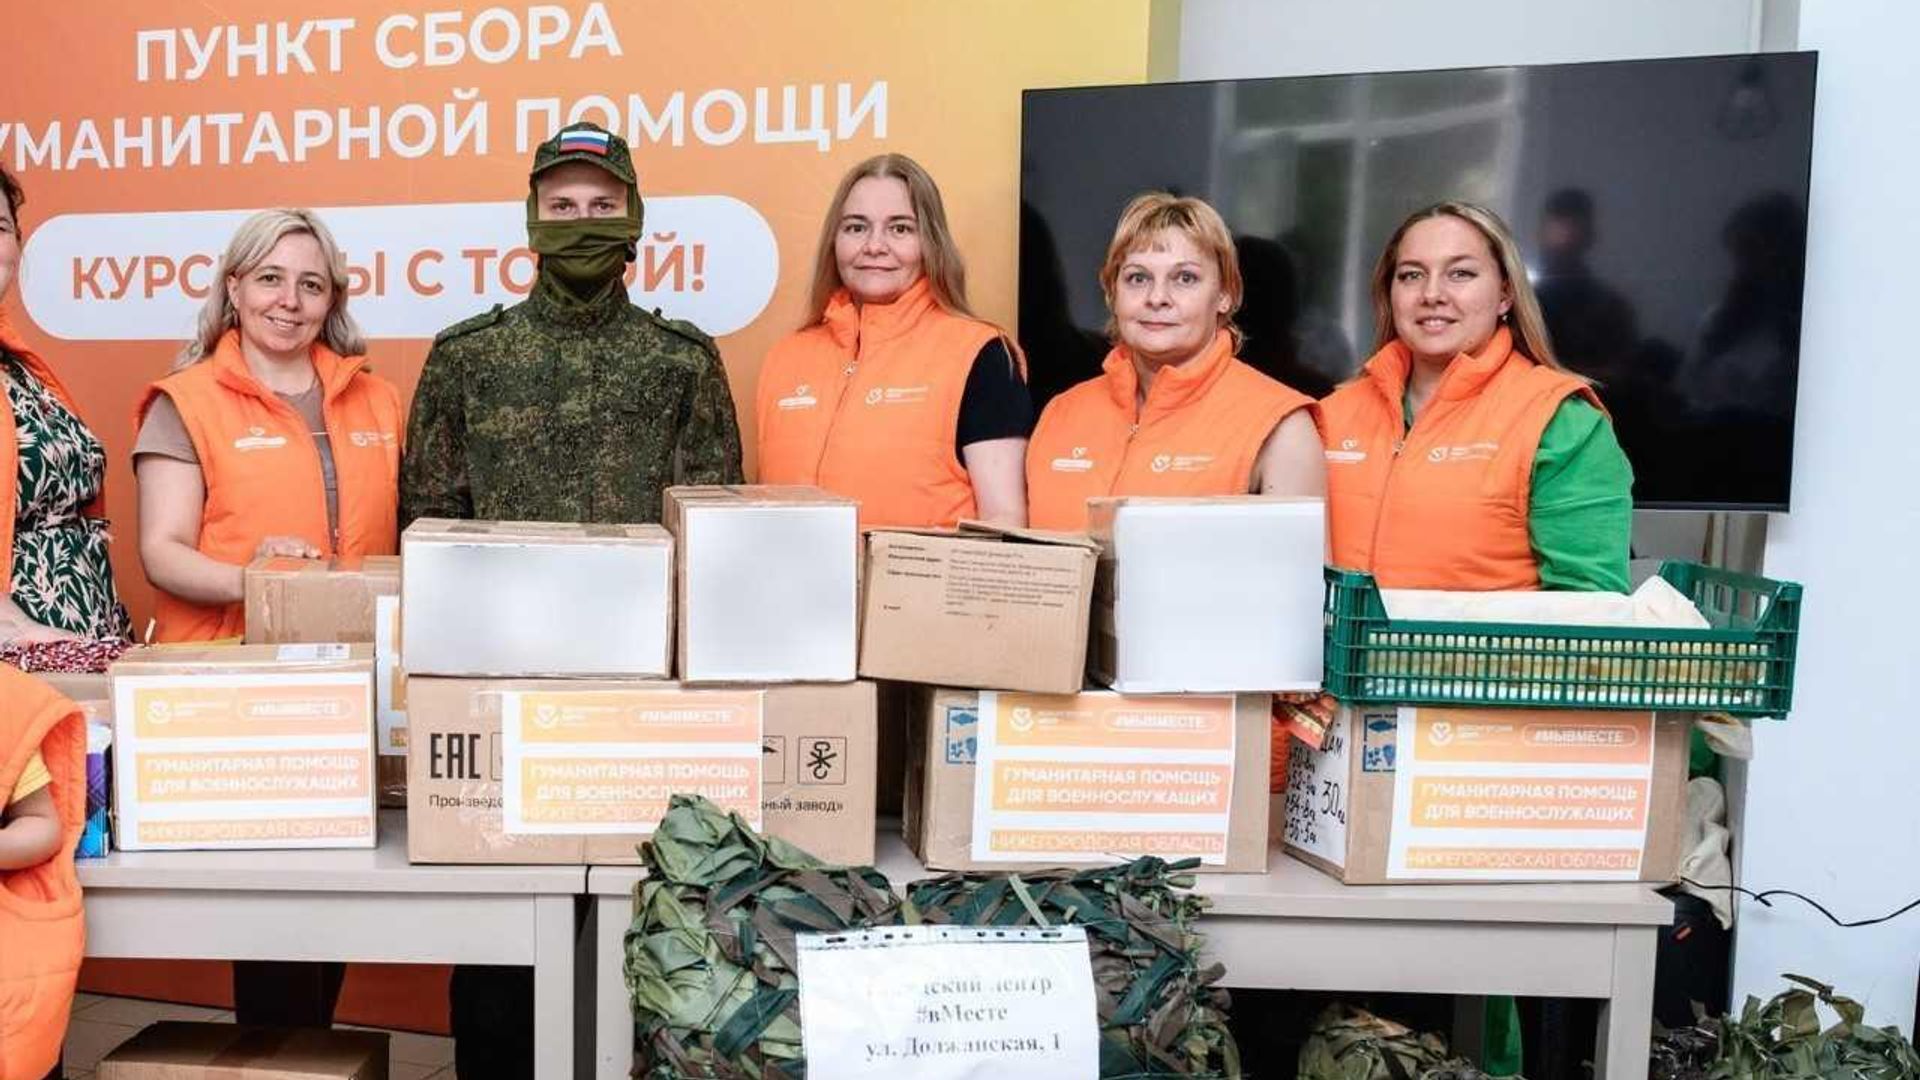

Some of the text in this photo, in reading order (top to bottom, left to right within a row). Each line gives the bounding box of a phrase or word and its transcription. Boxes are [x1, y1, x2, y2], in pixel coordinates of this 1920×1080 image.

[136, 2, 624, 82] ПУНКТ СБОРА
[516, 81, 889, 153] ПОМОЩИ
[406, 249, 444, 297] С
[461, 231, 706, 295] ТОЙ!
[667, 763, 750, 779] ПОМОЩЬ
[1140, 769, 1222, 786] ПОМОЩЬ
[1007, 787, 1045, 804] ДЛЯ
[1421, 783, 1637, 801] ГУМАНИТАРНАЯ ПОМОЩЬ
[1424, 804, 1635, 822] ДЛЯ ВОЕННОСЛУЖАЩИХ
